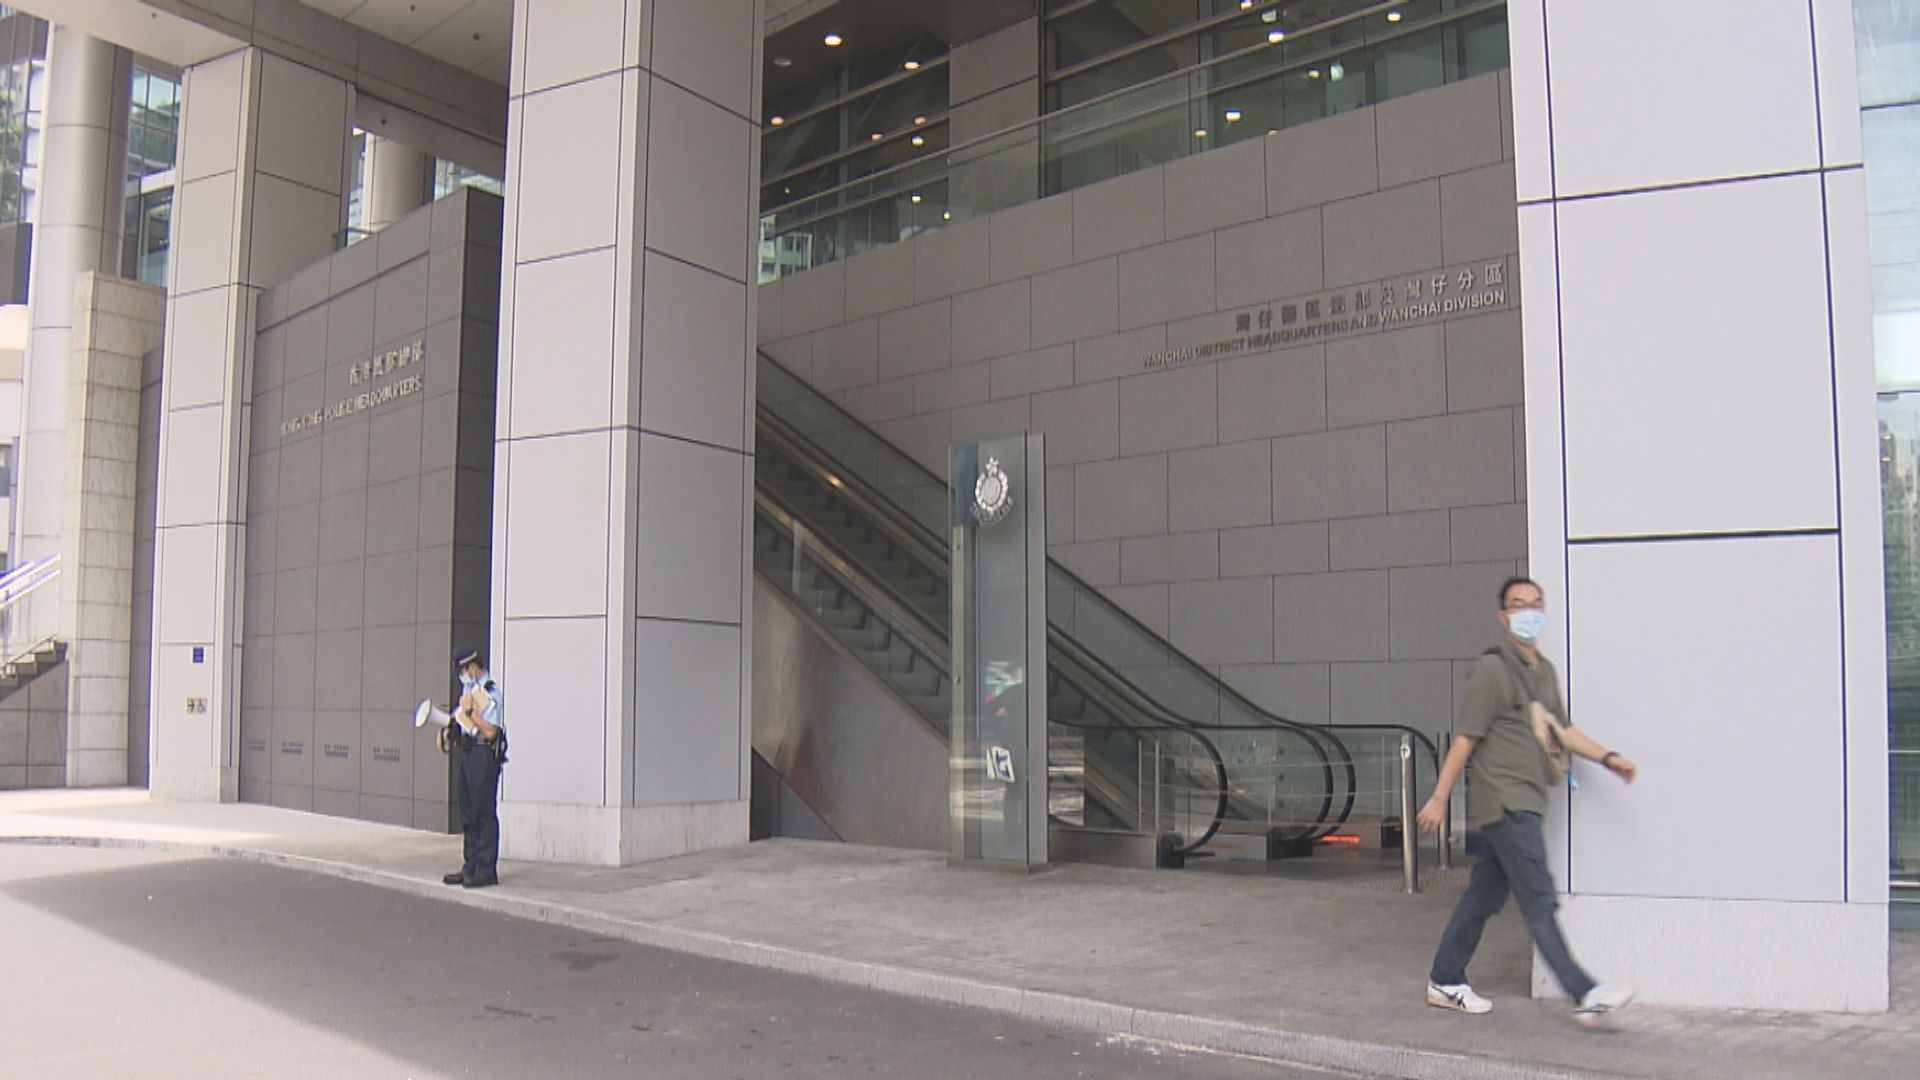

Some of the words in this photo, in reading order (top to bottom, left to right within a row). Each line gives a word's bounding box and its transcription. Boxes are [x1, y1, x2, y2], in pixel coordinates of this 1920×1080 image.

[1142, 347, 1194, 368] WANCHAI
[1195, 338, 1245, 358] DISTRICT
[1247, 320, 1349, 350] HEADQUARTERS
[1350, 313, 1378, 331] AND
[1378, 303, 1442, 325] WANCHAI
[1444, 290, 1505, 313] DIVISION
[1235, 263, 1505, 333] 仔區部及仔分區
[353, 374, 422, 413] HEADQUARTERS
